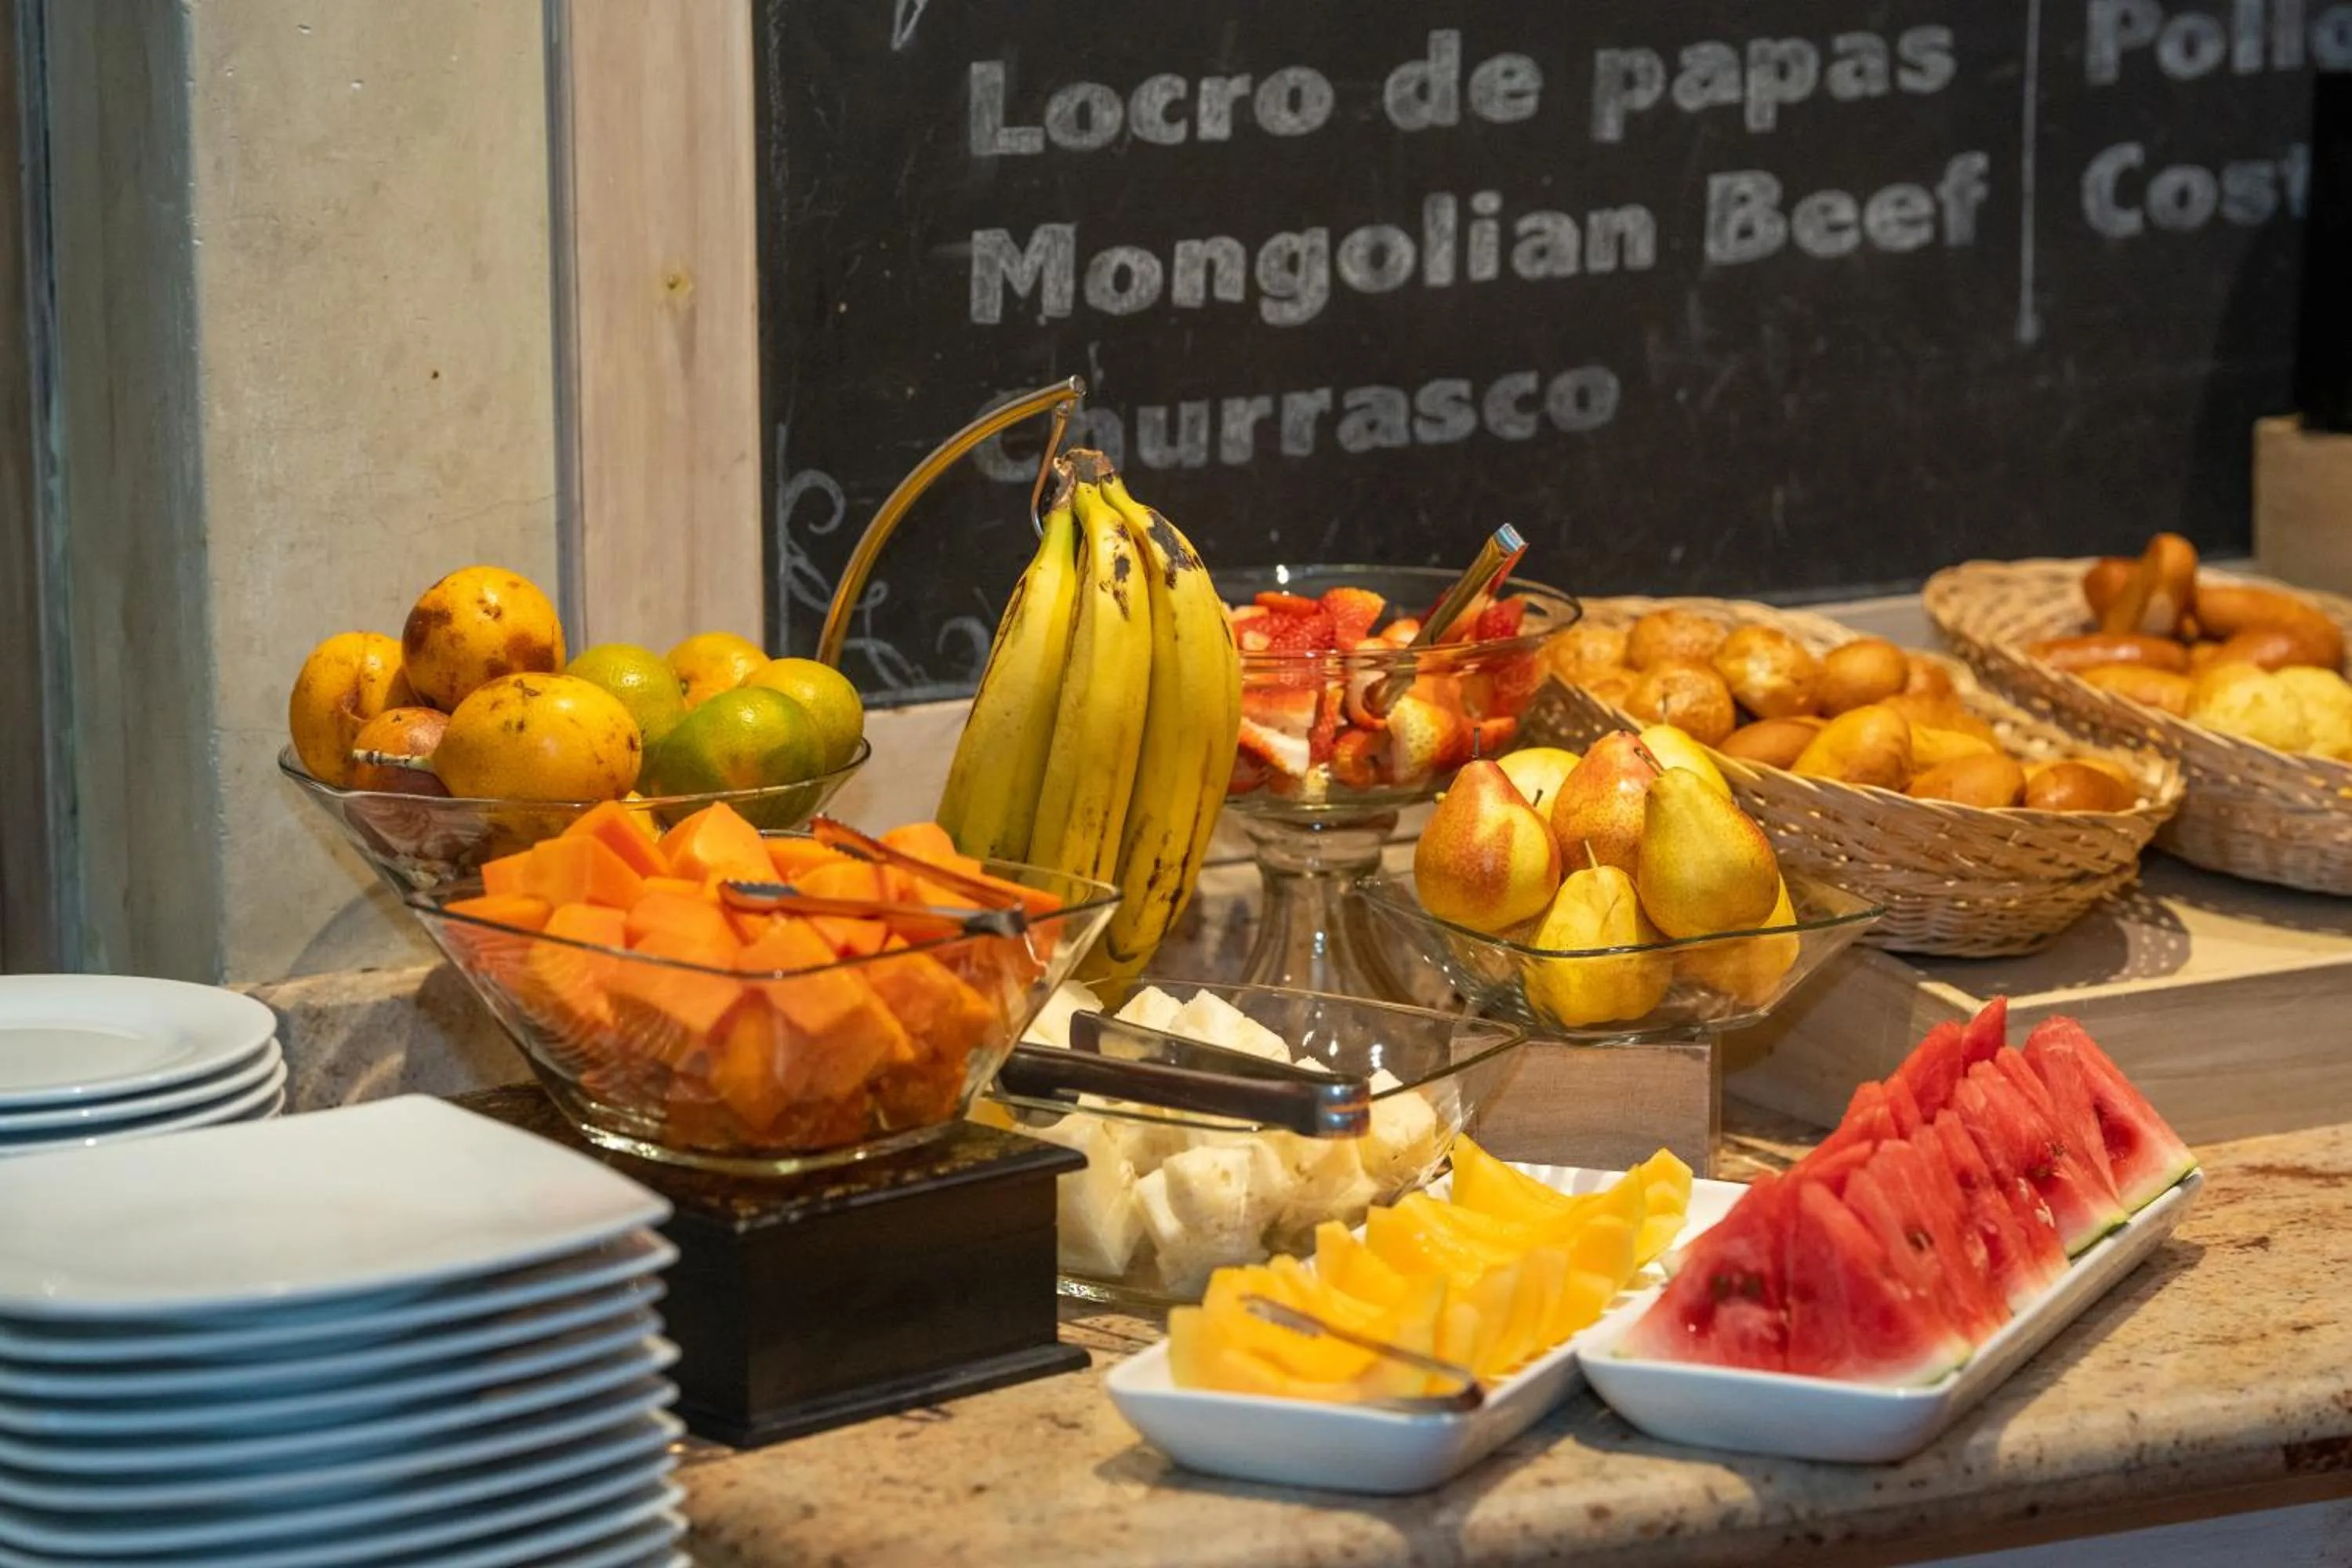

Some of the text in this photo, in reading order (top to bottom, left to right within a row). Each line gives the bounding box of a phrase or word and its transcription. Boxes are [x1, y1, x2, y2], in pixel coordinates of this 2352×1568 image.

[969, 24, 1956, 156] Locro de papas
[970, 151, 1990, 327] Mongolian Beef
